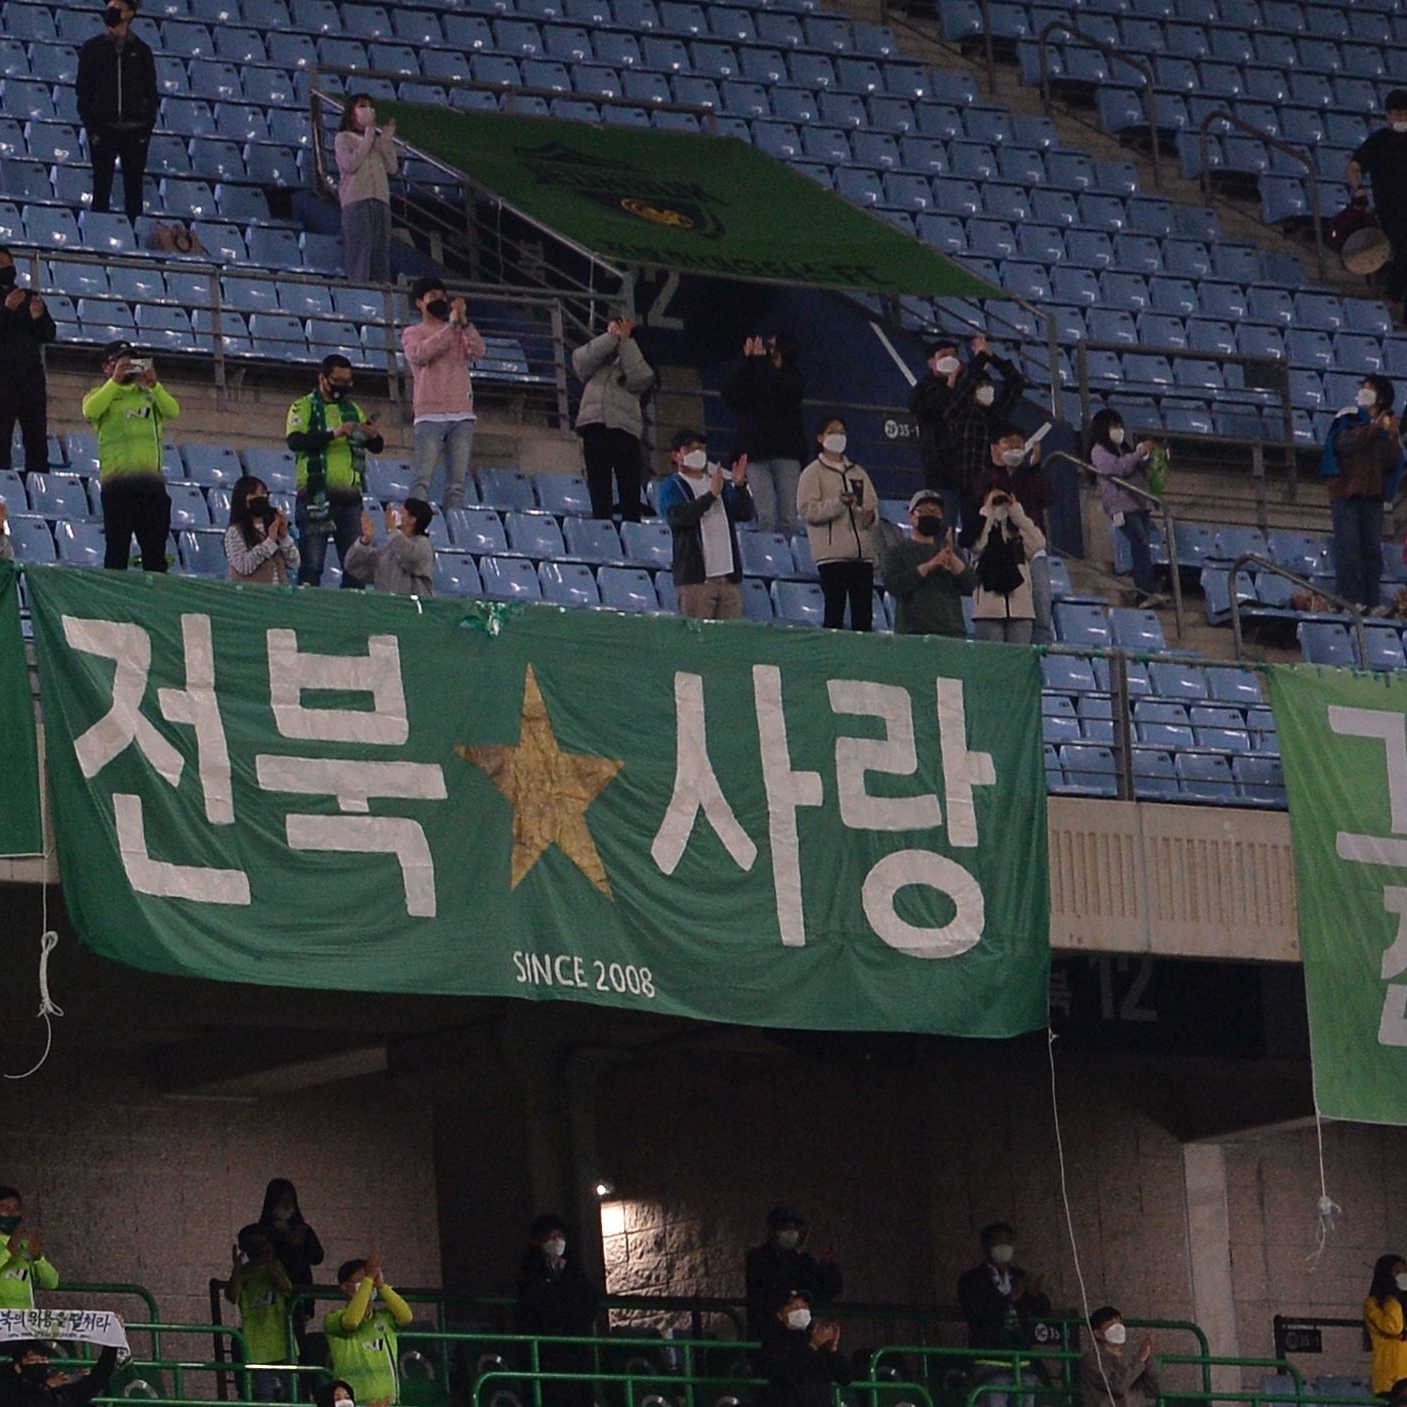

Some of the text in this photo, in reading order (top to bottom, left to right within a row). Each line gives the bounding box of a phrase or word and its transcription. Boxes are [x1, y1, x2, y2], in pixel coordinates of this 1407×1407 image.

[63, 613, 447, 918] 전북
[650, 665, 996, 959] 사랑
[513, 952, 656, 999] SINCE 2008
